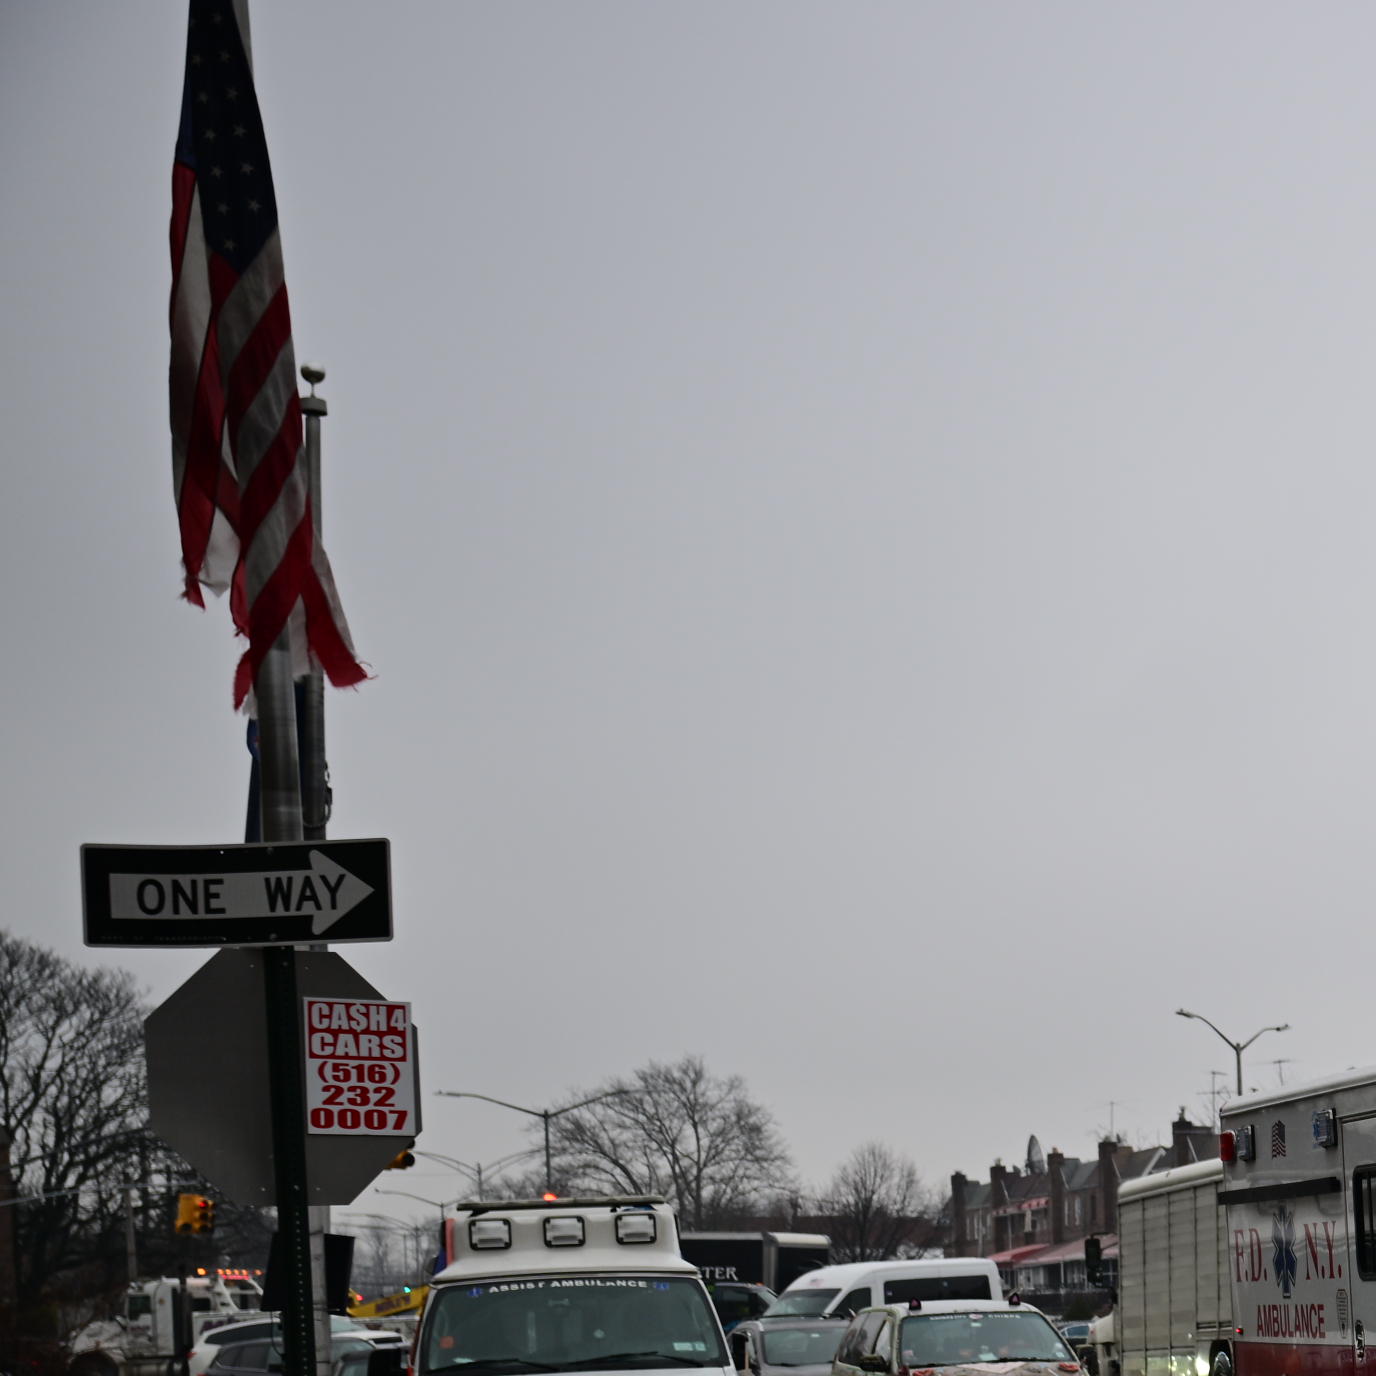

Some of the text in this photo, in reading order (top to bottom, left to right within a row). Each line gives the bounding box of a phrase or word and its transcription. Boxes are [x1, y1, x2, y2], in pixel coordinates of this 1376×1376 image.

[137, 873, 346, 915] ONE WAY
[311, 1032, 405, 1059] CARS
[318, 1061, 401, 1085] (516)
[322, 1085, 396, 1107] 232
[310, 1108, 408, 1130] 0007
[550, 1279, 648, 1289] AMBULANCE
[1256, 1304, 1326, 1339] AMBULANCE
